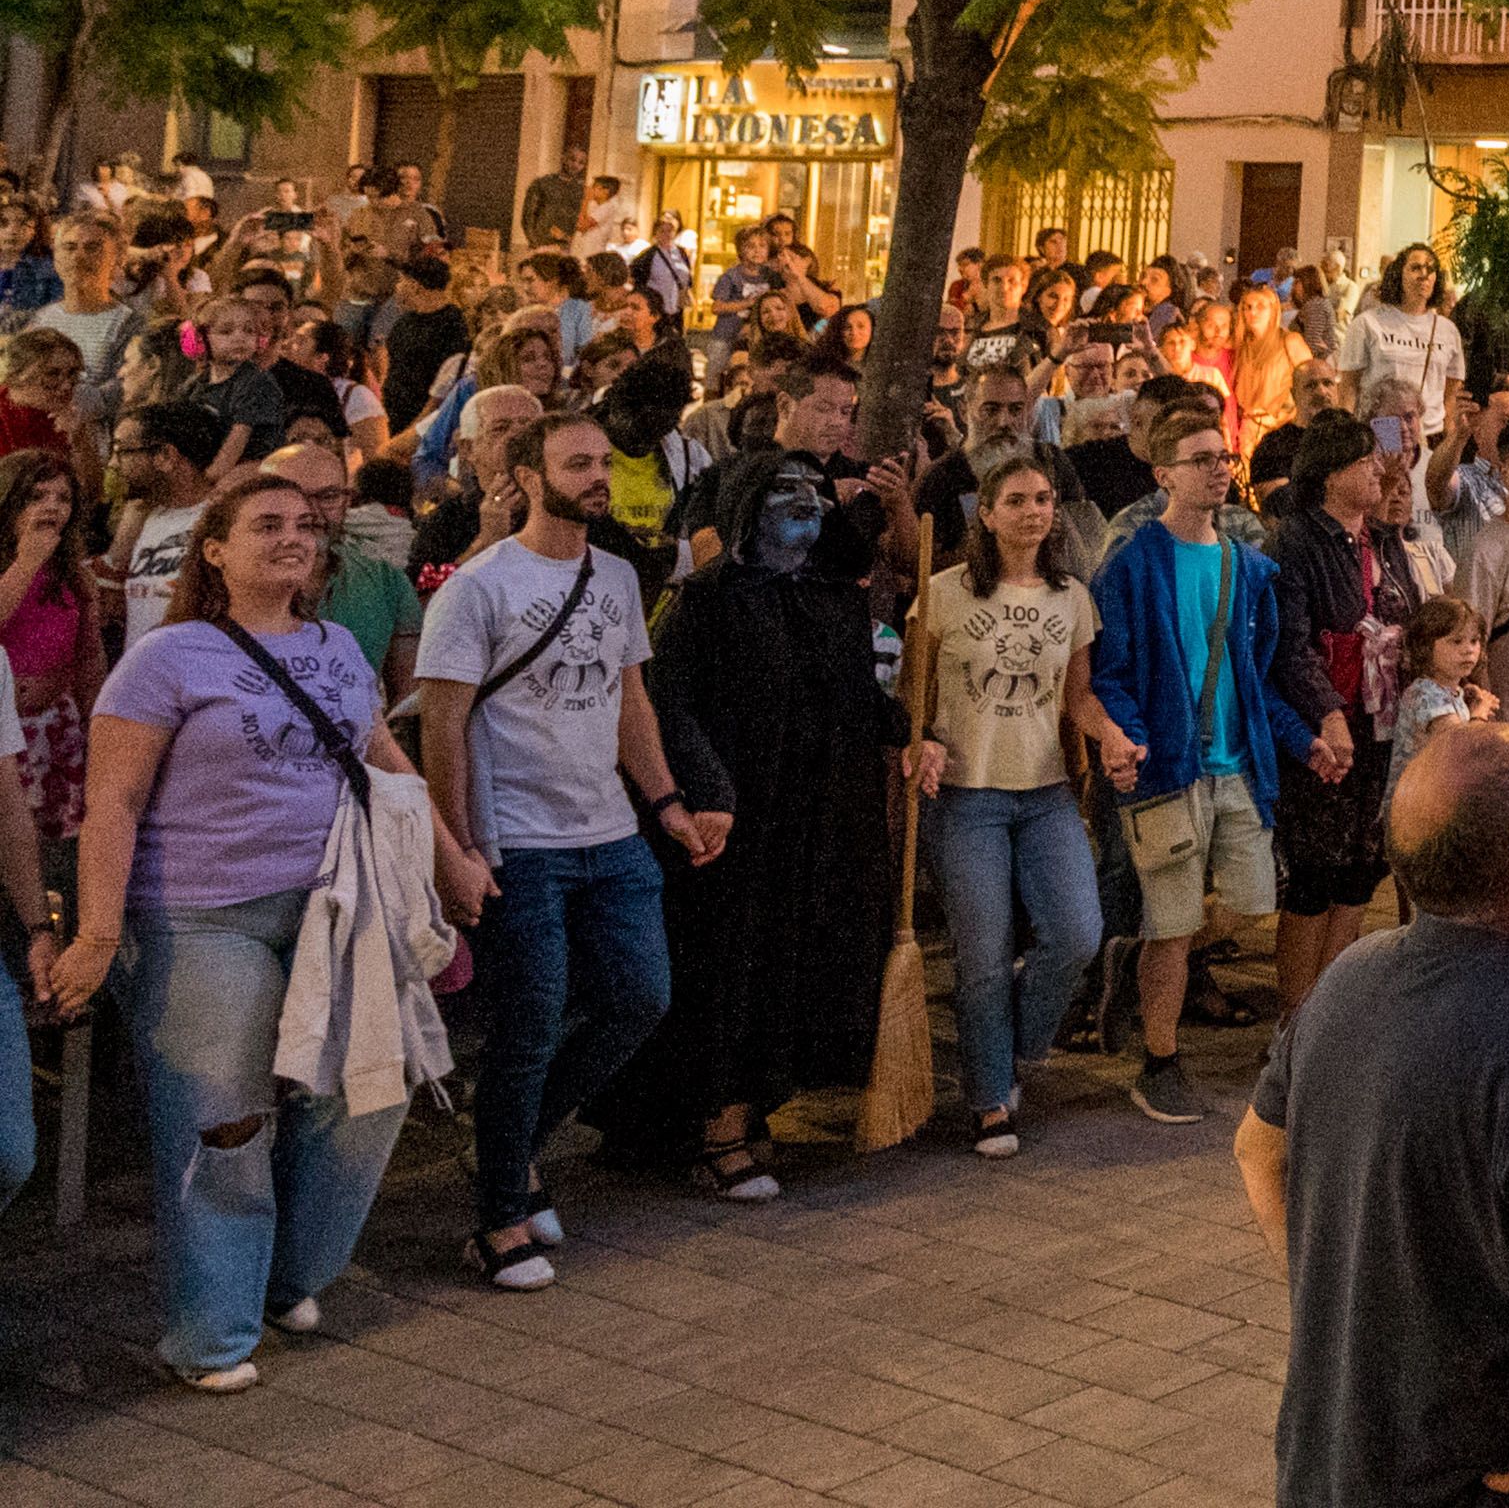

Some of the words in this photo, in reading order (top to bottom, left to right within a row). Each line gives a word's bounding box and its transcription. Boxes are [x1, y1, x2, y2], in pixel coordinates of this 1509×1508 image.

[692, 75, 752, 105] LA
[690, 113, 885, 145] LYONESA
[1382, 333, 1445, 350] Mother
[1002, 604, 1040, 622] 100
